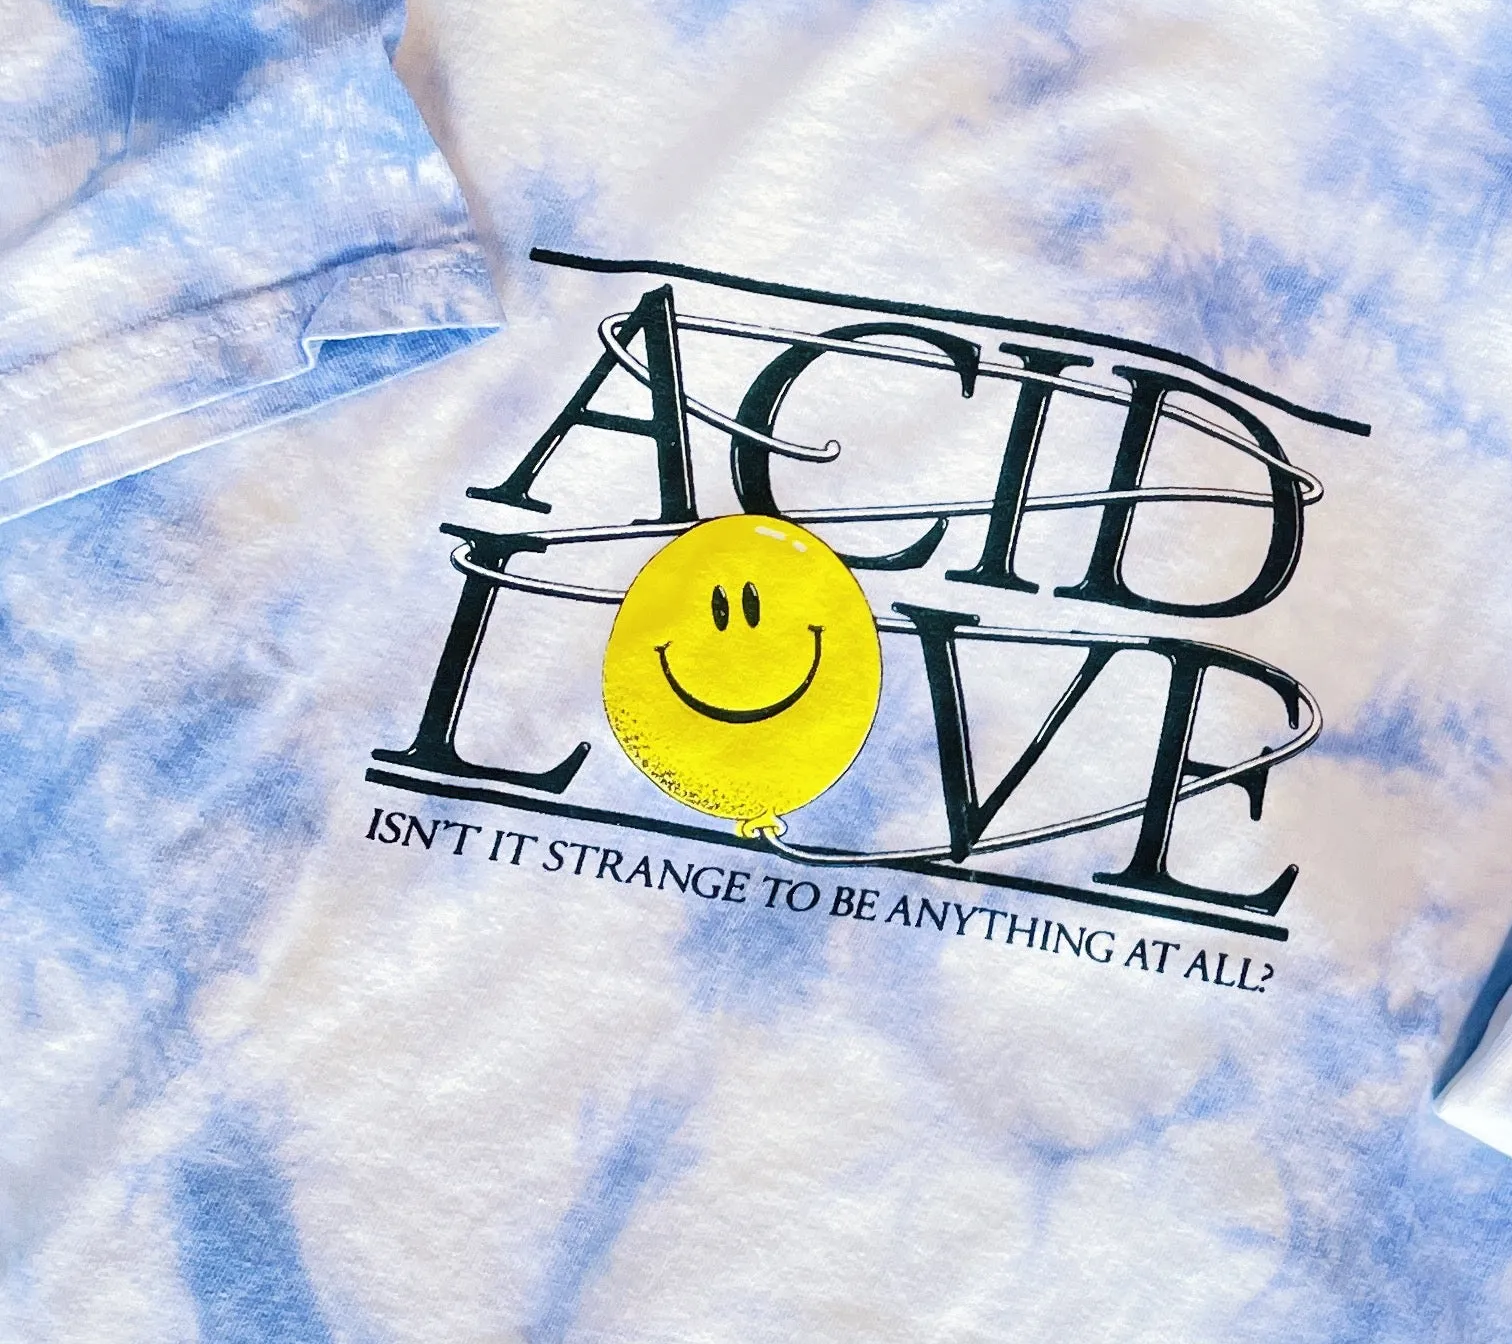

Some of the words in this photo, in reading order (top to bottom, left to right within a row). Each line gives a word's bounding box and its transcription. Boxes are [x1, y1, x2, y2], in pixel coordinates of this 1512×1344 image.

[466, 284, 1308, 619] ACID
[364, 807, 482, 856] ISN'T
[488, 829, 538, 866] IT
[543, 839, 752, 905] STRANGE
[763, 874, 821, 913] TO
[829, 886, 881, 922] BE
[884, 894, 1116, 964] ANYTHING
[1124, 937, 1181, 975] AT
[1183, 949, 1275, 995] ALL?
